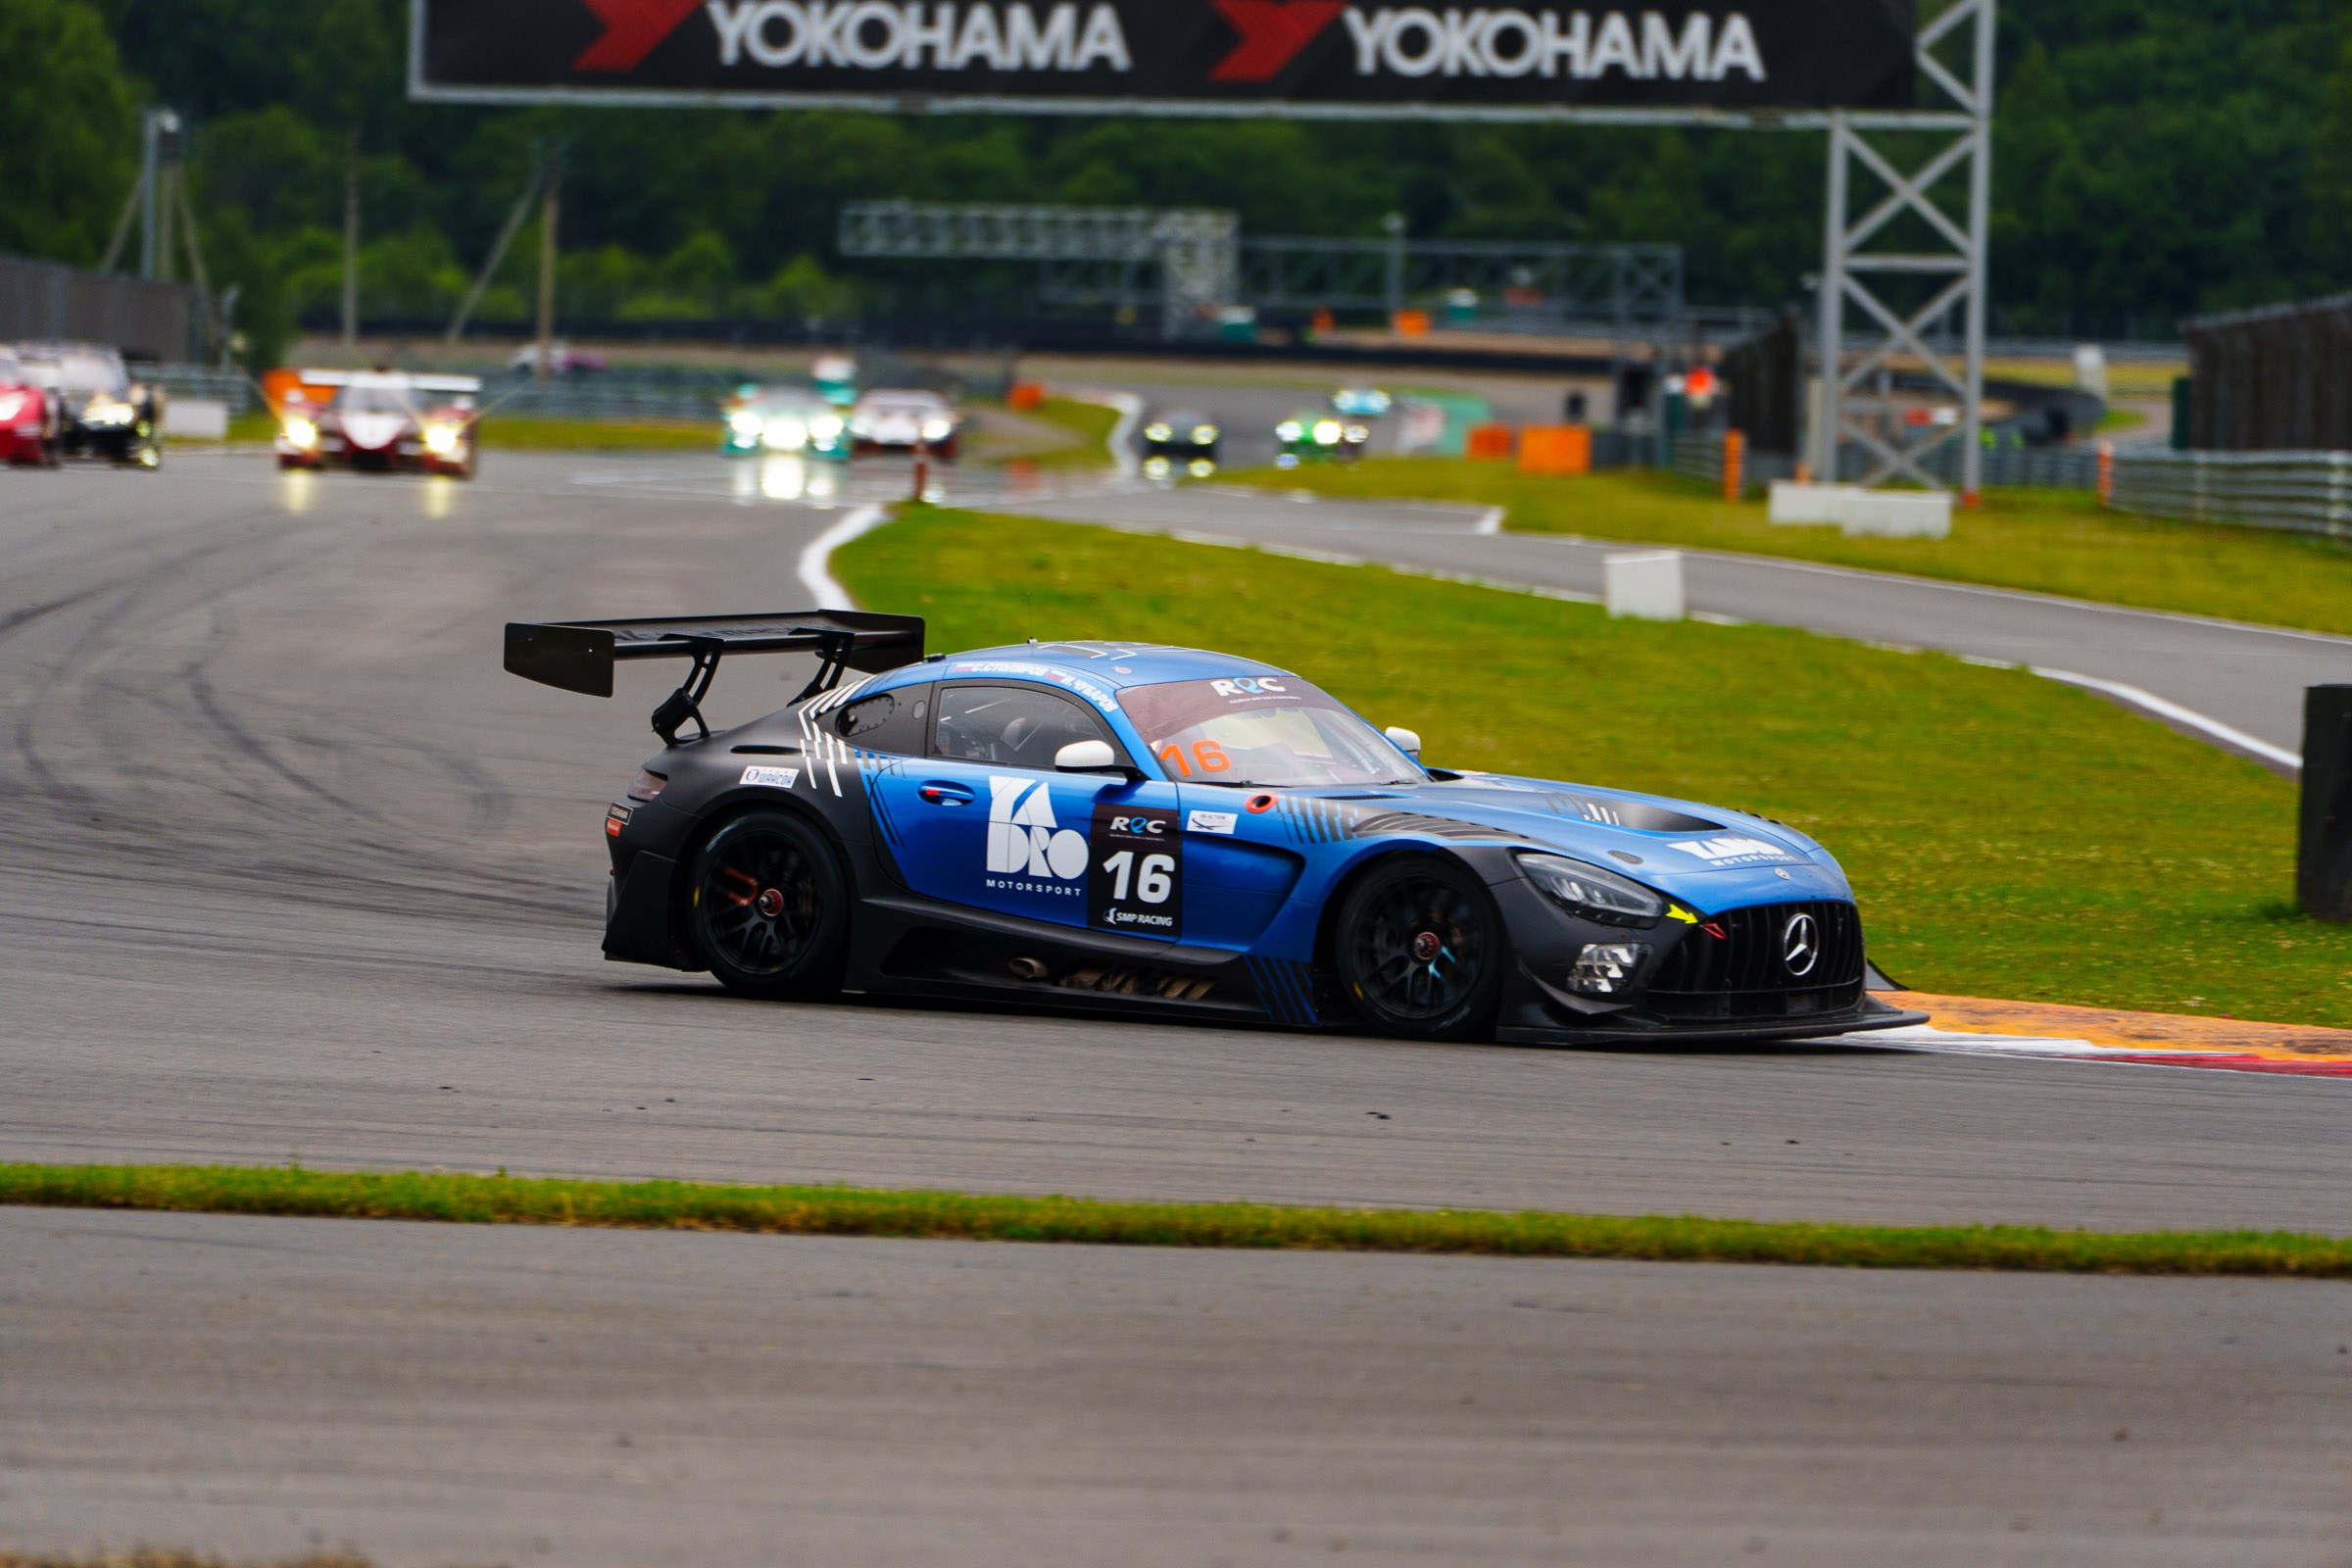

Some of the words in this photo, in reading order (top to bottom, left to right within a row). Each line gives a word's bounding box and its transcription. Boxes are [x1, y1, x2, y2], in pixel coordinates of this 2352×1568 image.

[707, 1, 1134, 72] YOKOHAMA
[1344, 8, 1767, 81] YOKOHAMA
[1159, 740, 1232, 777] 16
[986, 879, 1081, 896] MOTORSPORT
[1102, 851, 1175, 904] 16
[1115, 912, 1138, 922] SMP
[1138, 914, 1173, 927] RACING
